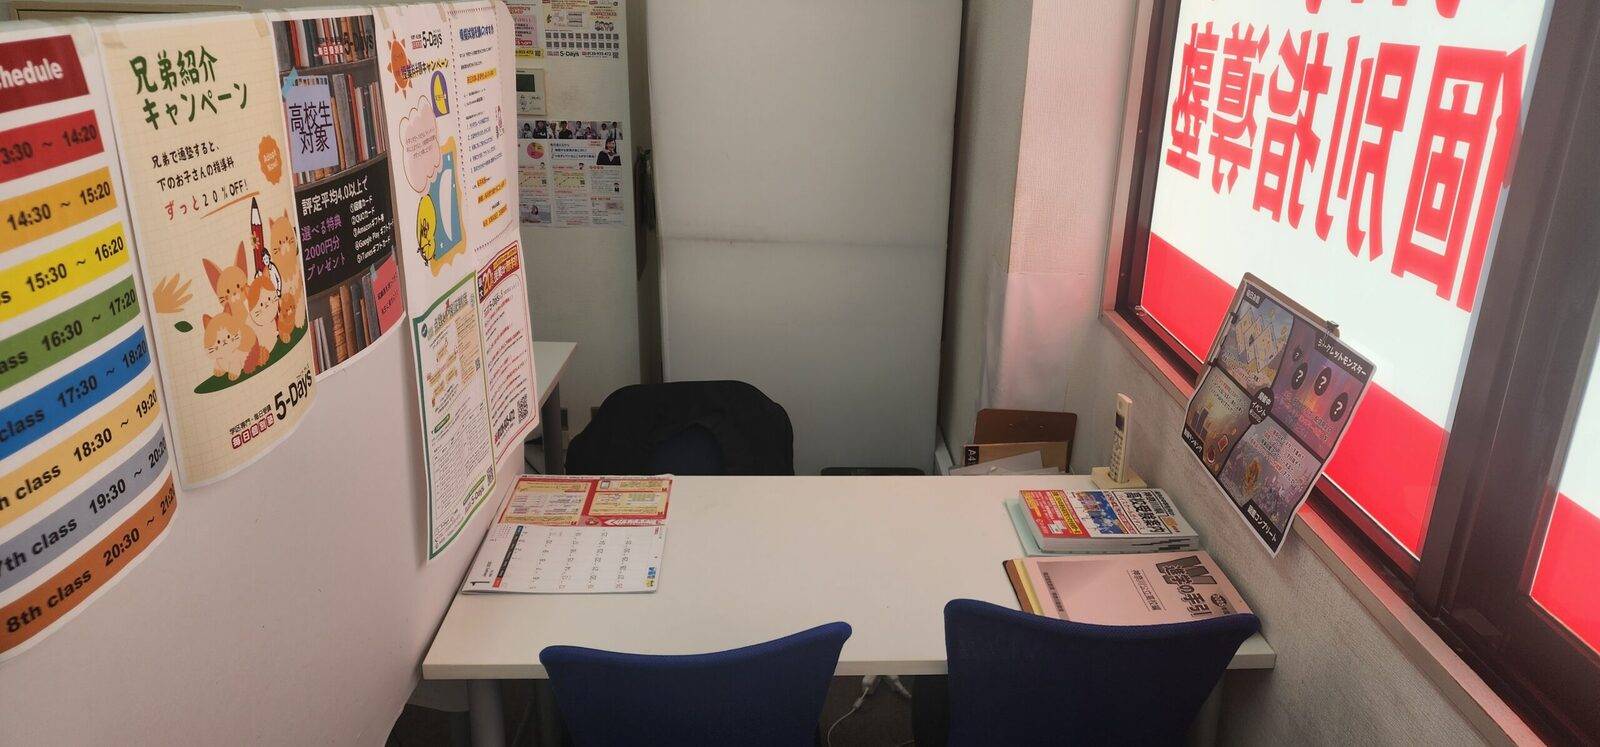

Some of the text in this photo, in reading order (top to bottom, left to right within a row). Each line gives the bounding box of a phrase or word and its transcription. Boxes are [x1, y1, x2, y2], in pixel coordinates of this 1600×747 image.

[422, 30, 443, 49] 5-Days
[0, 58, 64, 89] hedule
[129, 45, 218, 94] 兄弟紹介
[142, 83, 247, 130] キャンペーン
[289, 101, 333, 132] 高校生
[62, 124, 97, 147] 14:20
[151, 141, 220, 169] 兄弟で通塾すると、
[299, 126, 330, 154] 対象
[156, 156, 235, 191] 下のお子さんの指導料
[7, 204, 52, 231] 14:30
[80, 181, 111, 206] 15:20
[301, 175, 368, 216] 評定平均4.0以上で
[301, 214, 343, 242] 選べる特典
[304, 235, 341, 261] 2000円分
[26, 263, 67, 292] 15:30
[94, 236, 124, 262] 16:20
[307, 252, 349, 280] プレゼント
[41, 320, 83, 351] 16:30
[109, 288, 136, 316] 17:20
[0, 407, 45, 443] class
[57, 375, 98, 408] 17:30
[122, 340, 147, 369] 18:20
[274, 369, 313, 420] 5-Days
[1252, 401, 1266, 416] イベント
[16, 465, 61, 500] class
[73, 428, 112, 462] 18:30
[136, 389, 157, 419] 19:20
[32, 518, 77, 555] class
[89, 478, 126, 515] 19:30
[1126, 491, 1165, 533] 高校受験案内
[6, 604, 43, 633] 8th
[47, 568, 92, 608] class
[103, 528, 140, 566] 20:30
